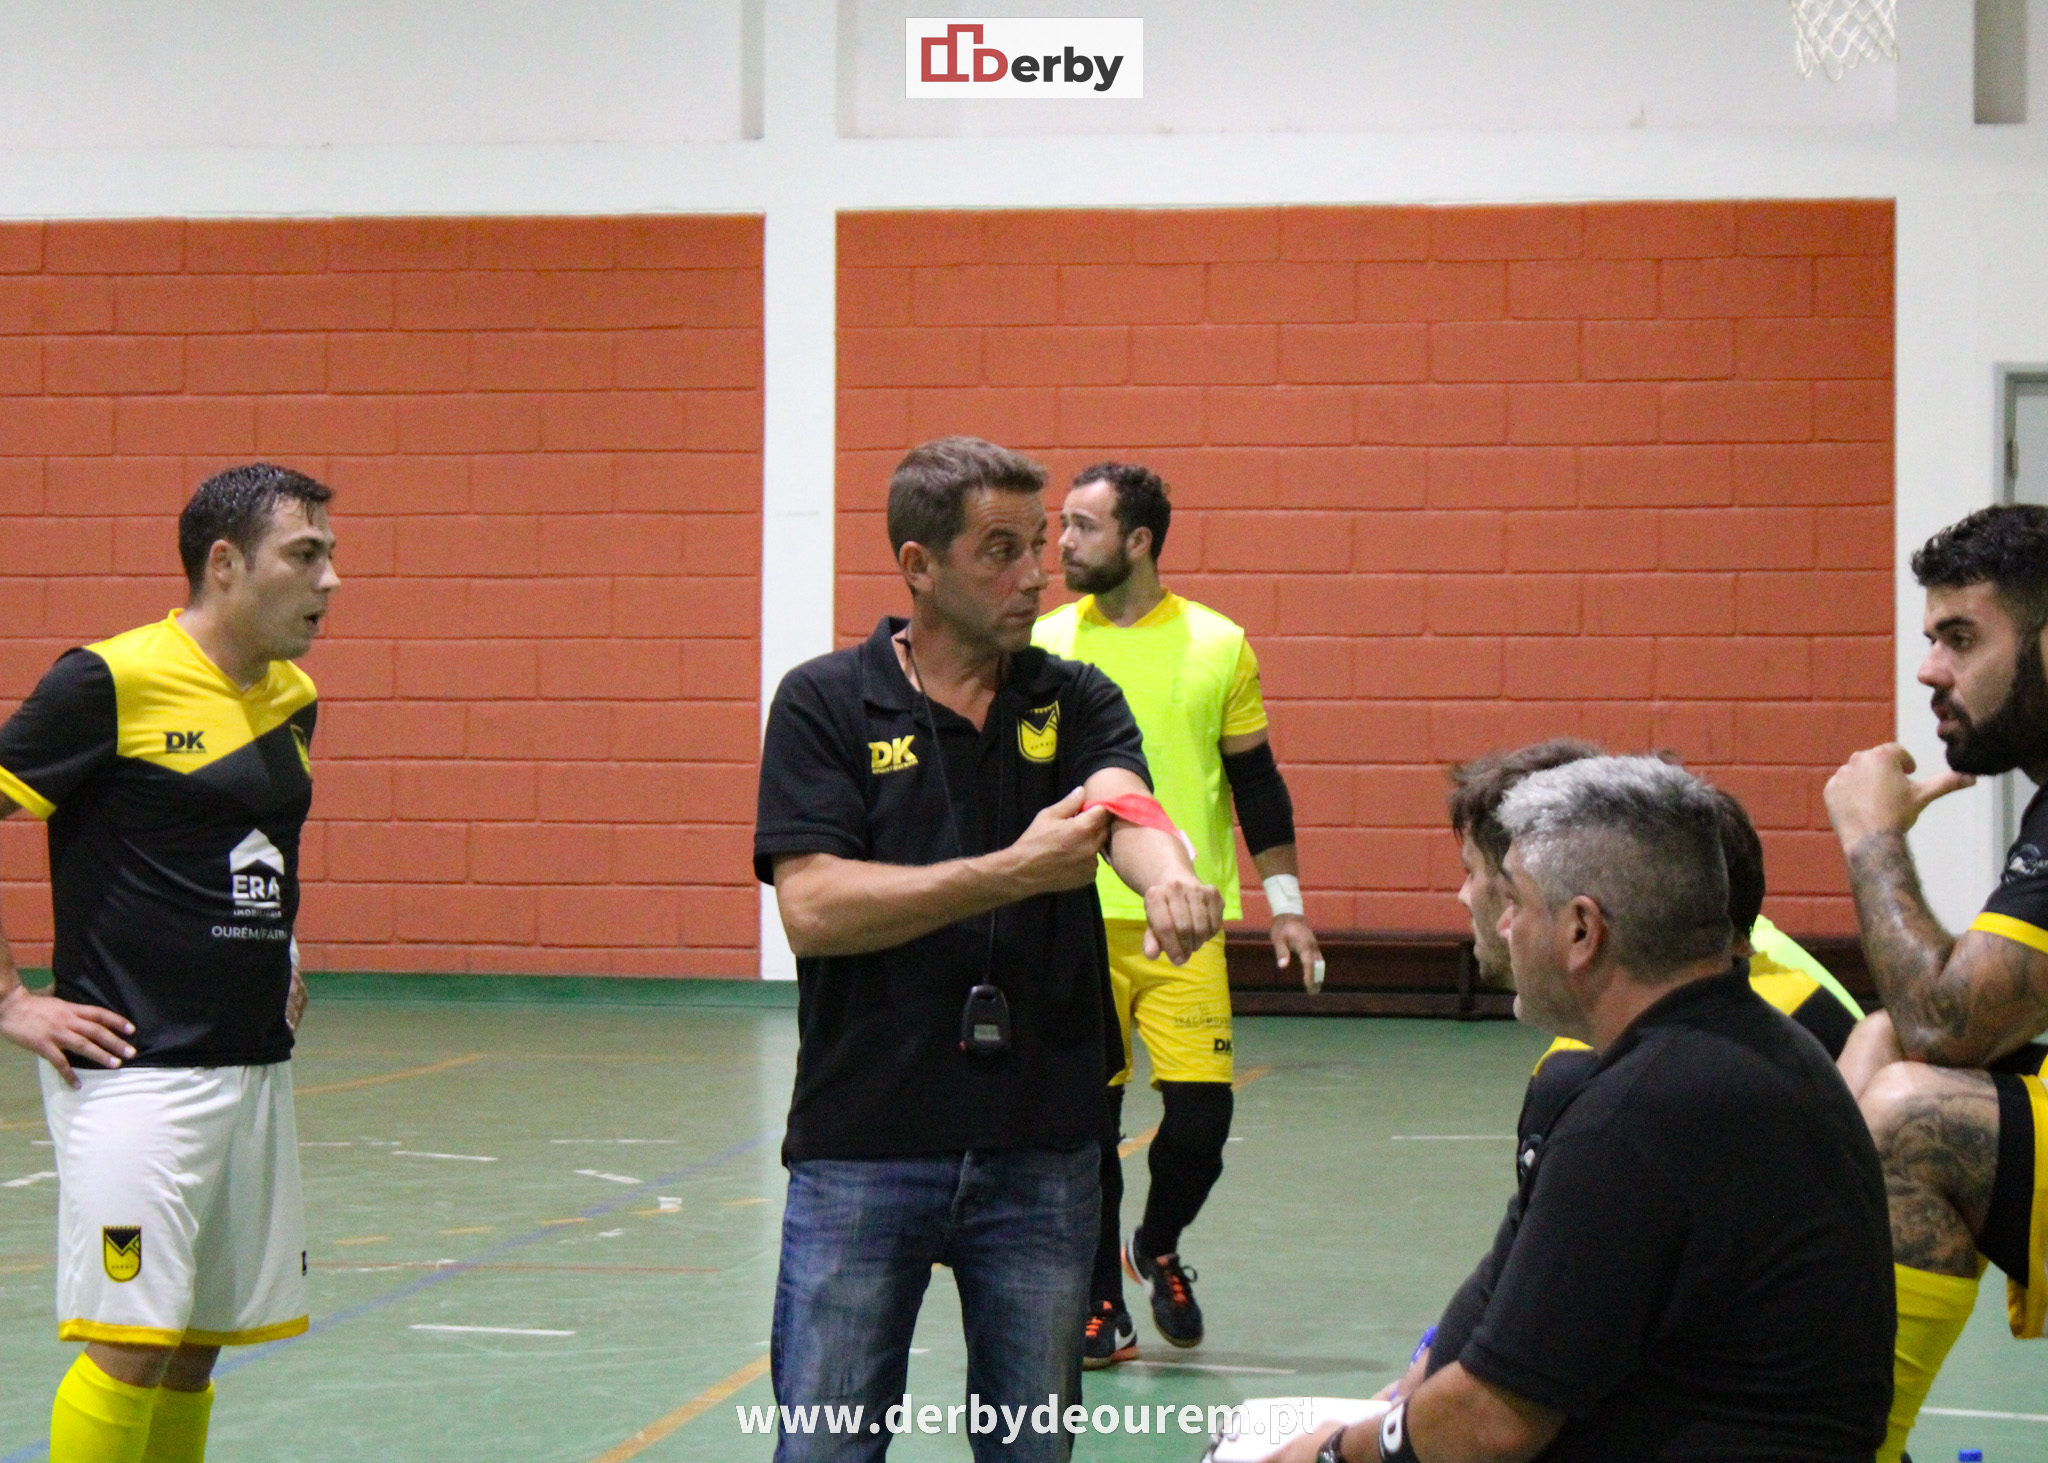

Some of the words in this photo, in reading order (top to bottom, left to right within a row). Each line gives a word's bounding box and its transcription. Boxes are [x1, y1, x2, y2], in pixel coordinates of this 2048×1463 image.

[163, 730, 206, 749] DK
[868, 734, 917, 768] DK
[232, 874, 281, 900] ERA
